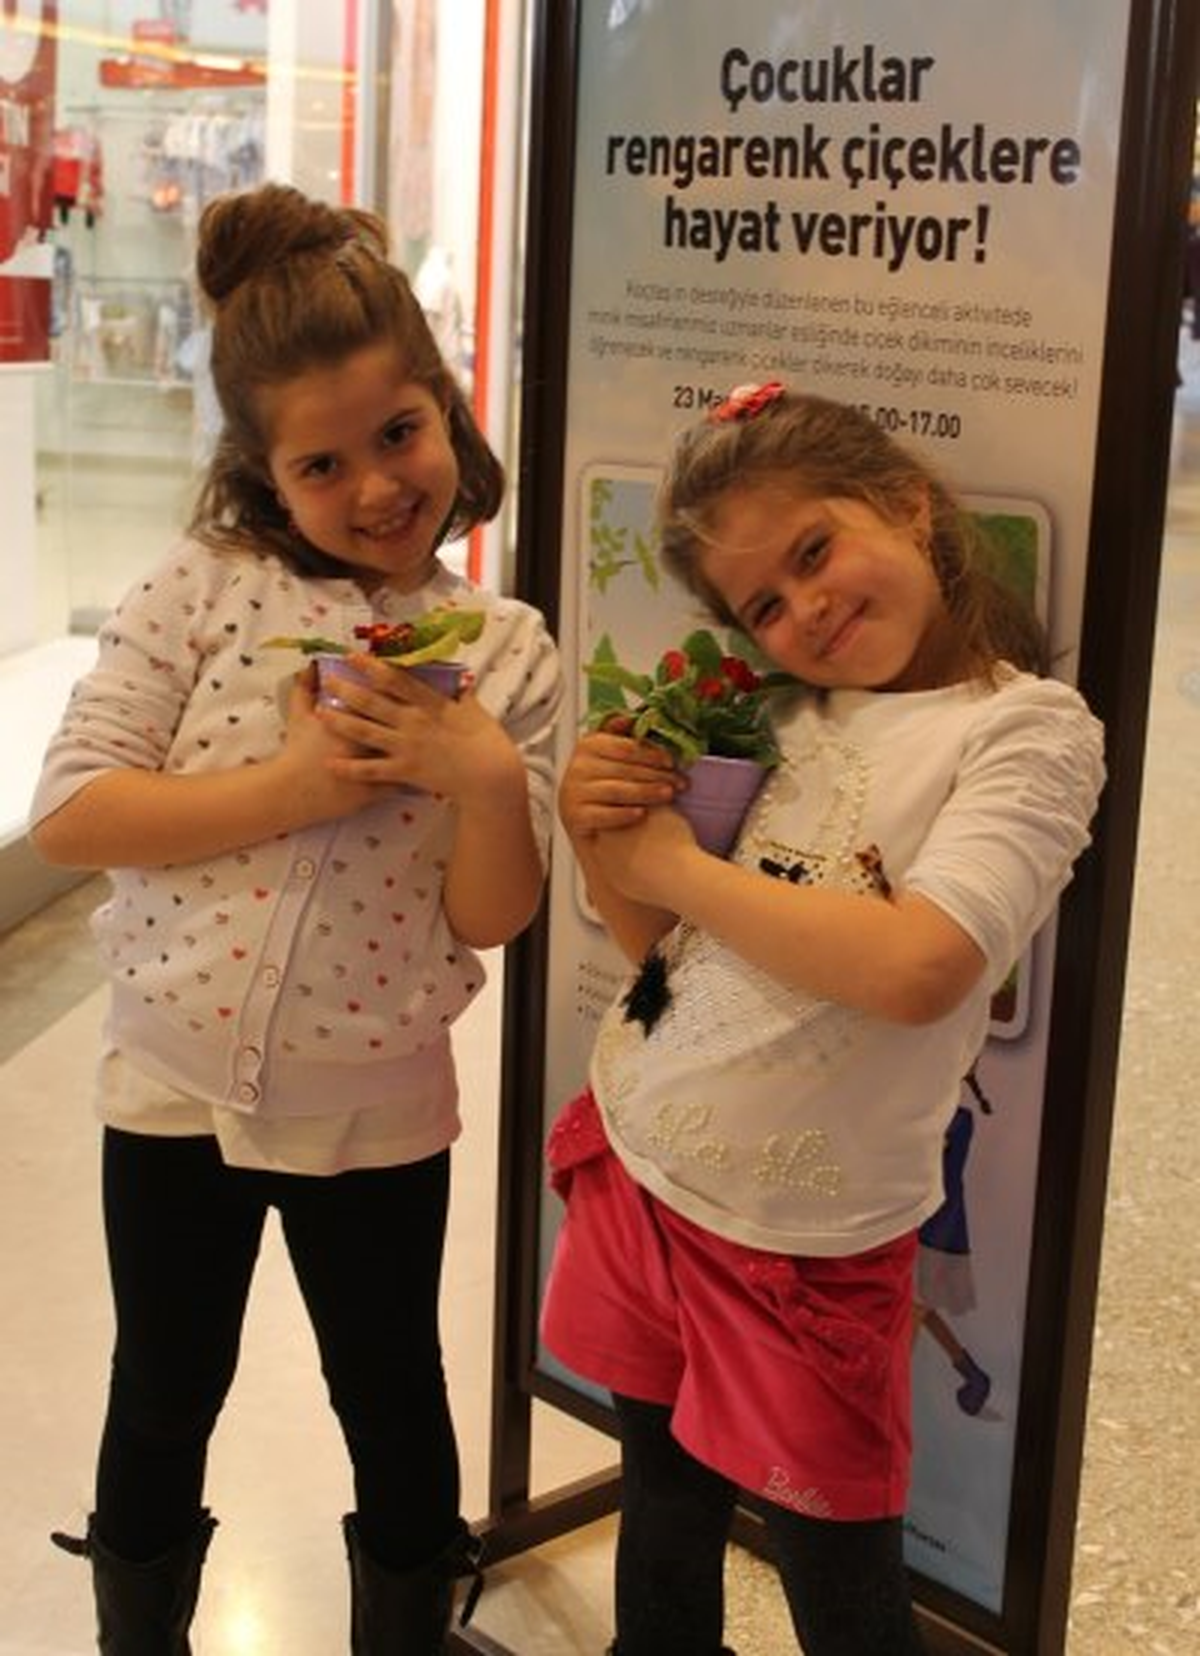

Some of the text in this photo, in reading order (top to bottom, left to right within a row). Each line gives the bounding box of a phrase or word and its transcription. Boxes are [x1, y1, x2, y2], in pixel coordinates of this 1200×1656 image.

[720, 45, 935, 112] Çocuklar
[605, 124, 1082, 190] rengarenk çiçeklere
[664, 197, 990, 272] hayat veriyor!
[854, 298, 874, 316] bu
[673, 386, 695, 409] 23
[926, 366, 967, 388] daha
[971, 371, 1000, 392] çok
